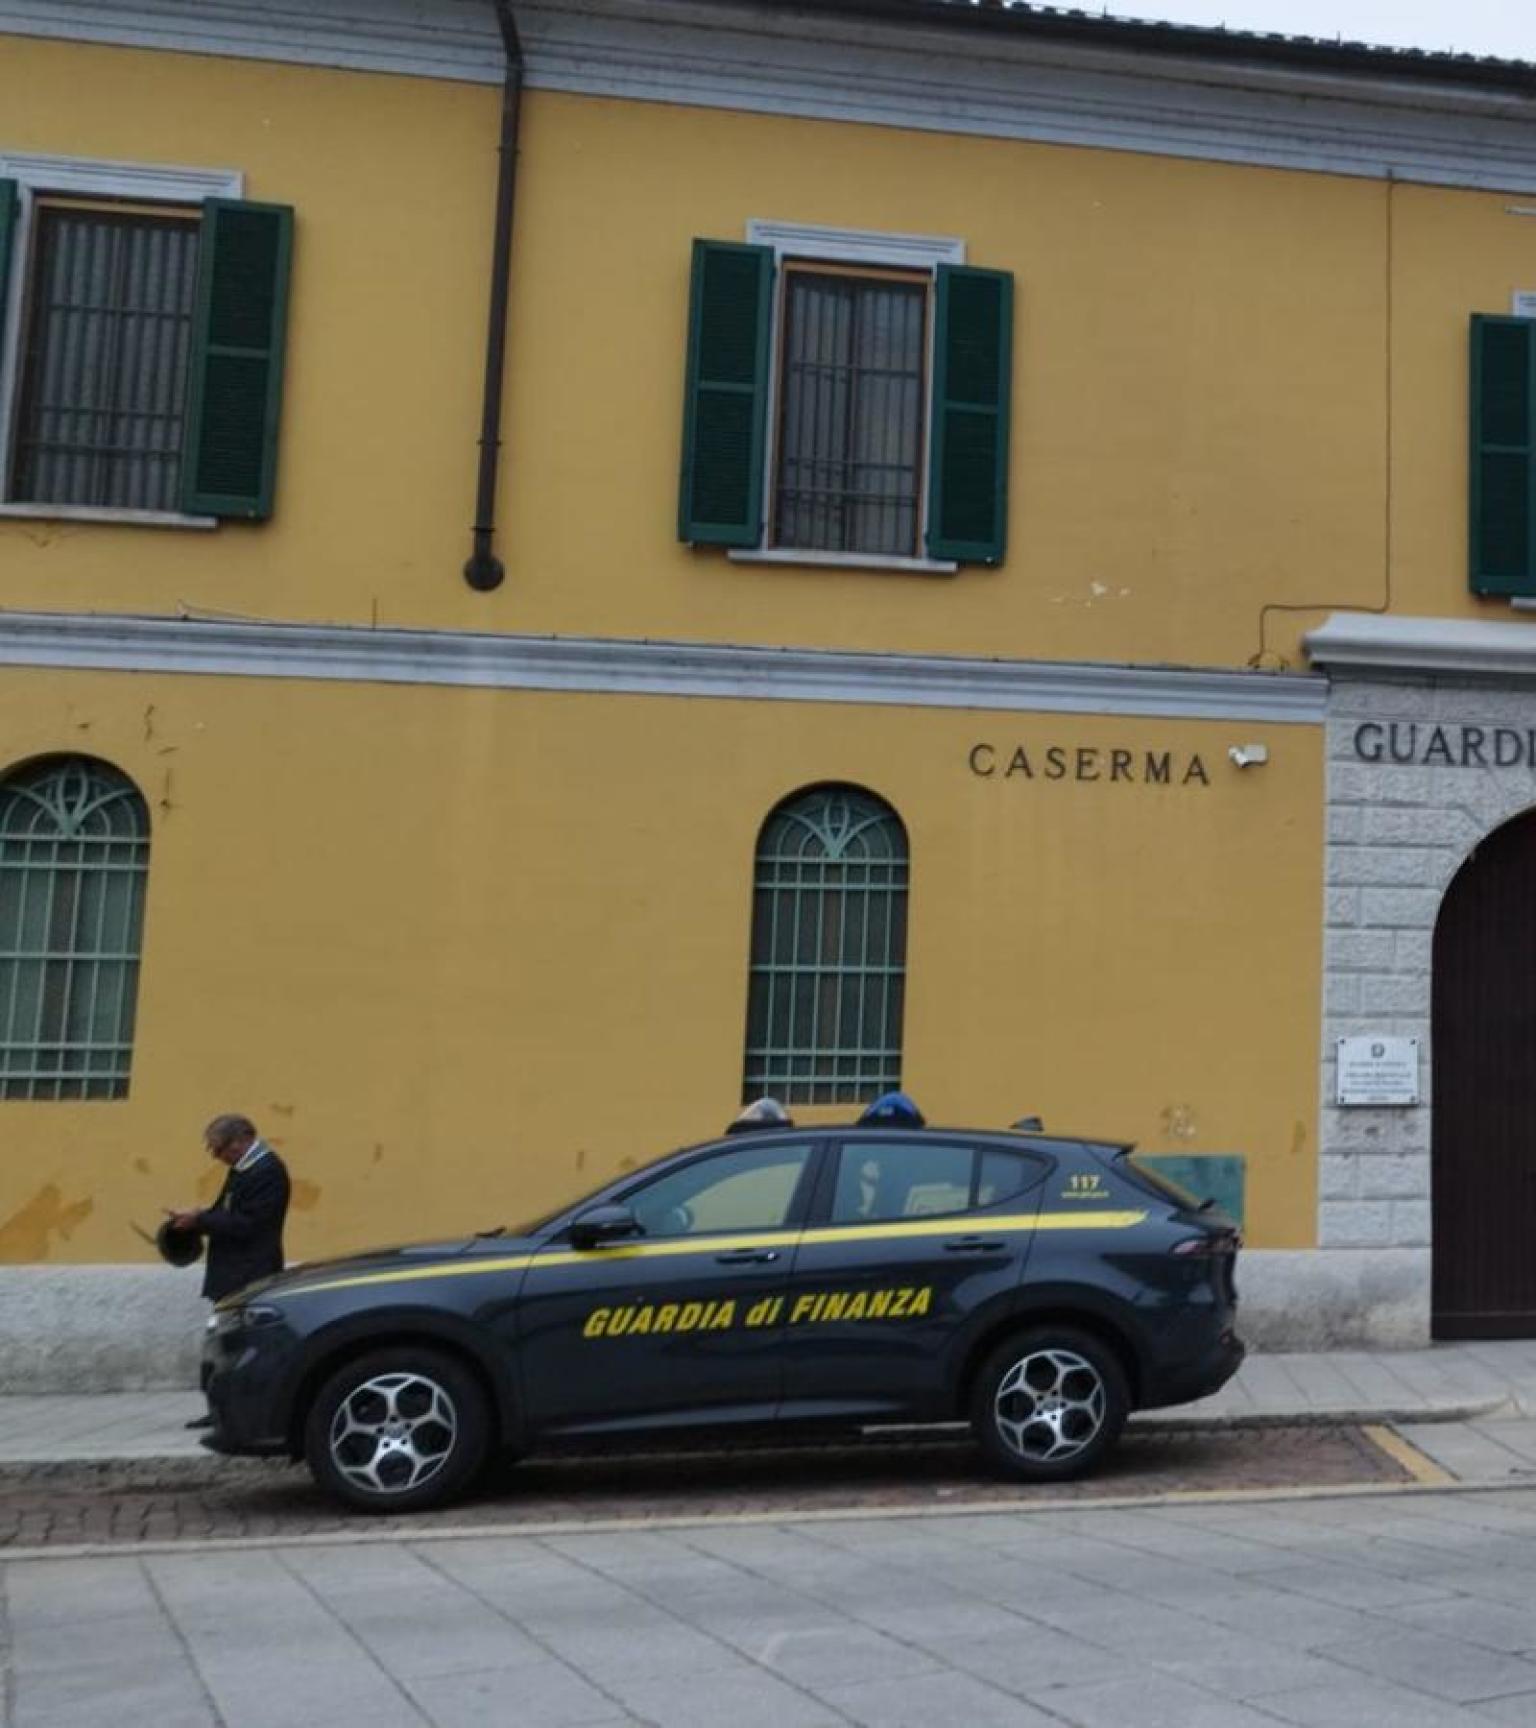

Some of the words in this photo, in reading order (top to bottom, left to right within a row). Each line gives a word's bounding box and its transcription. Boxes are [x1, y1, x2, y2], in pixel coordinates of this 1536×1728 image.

[968, 742, 1210, 786] CASERMA
[583, 1299, 735, 1337] GUARDIA
[789, 1287, 932, 1323] FINANZA
